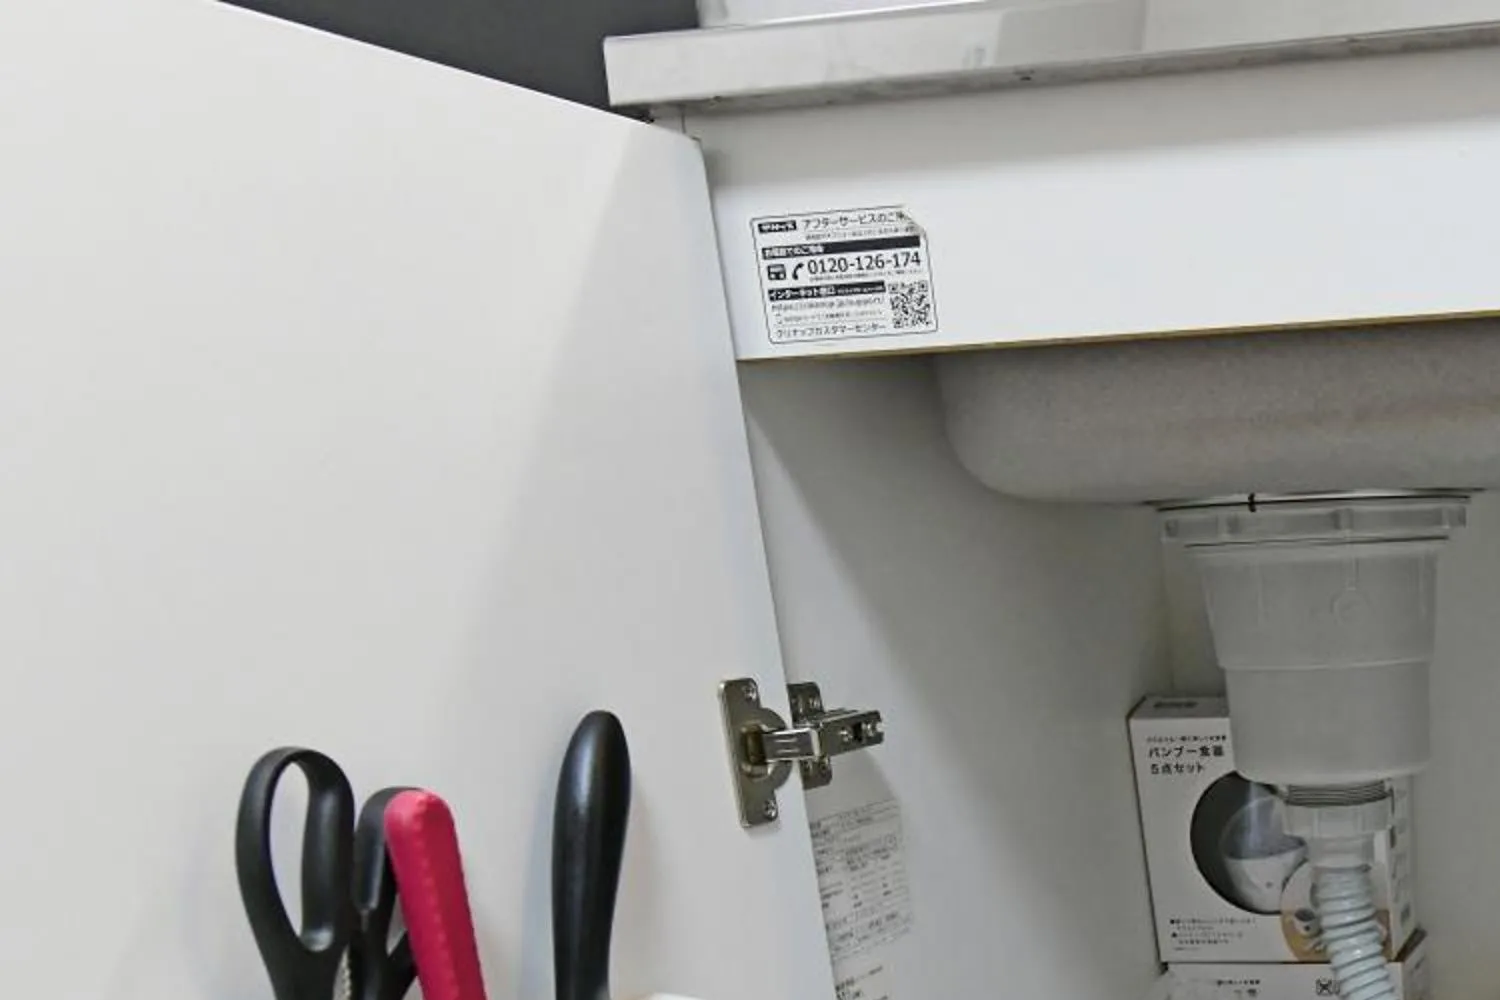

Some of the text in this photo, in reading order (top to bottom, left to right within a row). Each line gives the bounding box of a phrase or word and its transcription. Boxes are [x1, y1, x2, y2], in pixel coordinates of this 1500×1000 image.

[803, 212, 911, 230] アフターサービスのご
[808, 251, 921, 274] 0120-126-174
